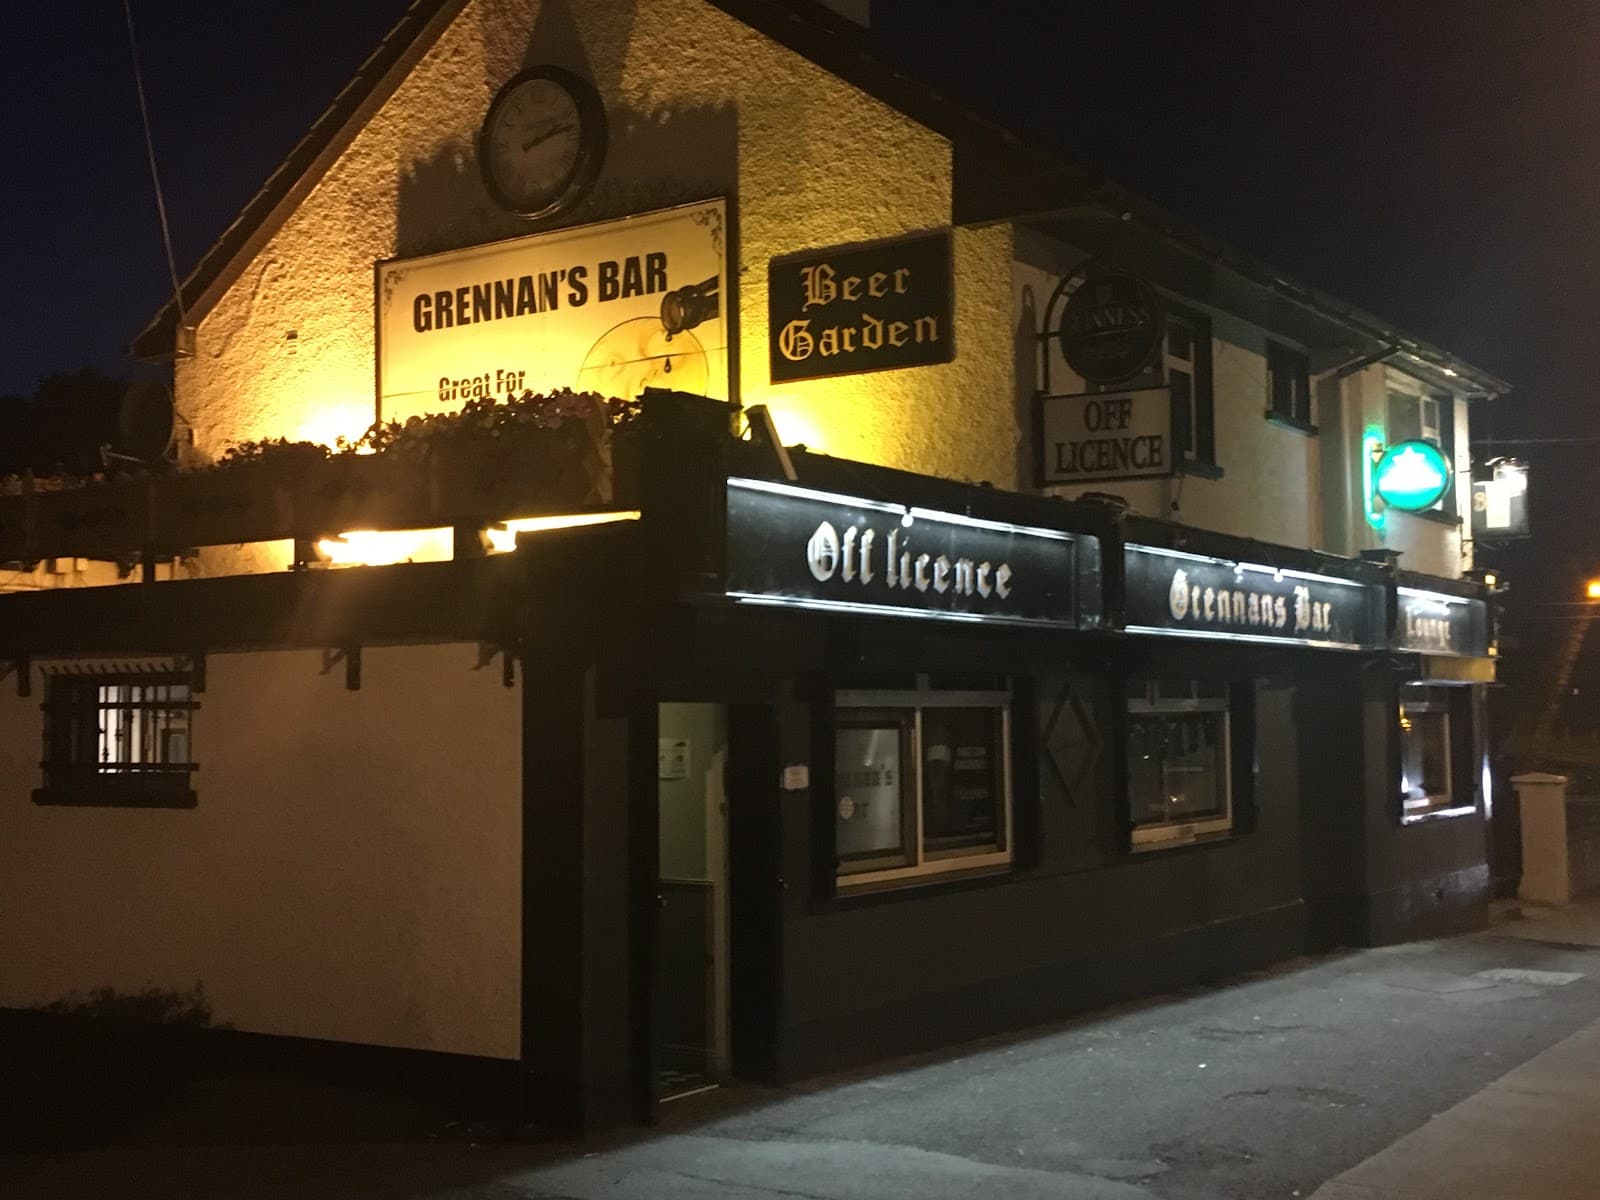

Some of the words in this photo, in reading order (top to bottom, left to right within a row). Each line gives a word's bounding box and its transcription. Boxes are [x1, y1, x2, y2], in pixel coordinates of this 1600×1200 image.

[413, 266, 588, 333] GRENNAN'S
[598, 252, 667, 302] BAR
[801, 263, 910, 312] Beer
[779, 312, 941, 361] Garden
[438, 374, 490, 401] Great
[498, 368, 526, 395] For
[1085, 399, 1133, 432] OFF
[1055, 435, 1163, 473] LICENCE
[807, 520, 876, 584] Off
[886, 527, 1012, 599] licence
[1294, 585, 1331, 632] Bar
